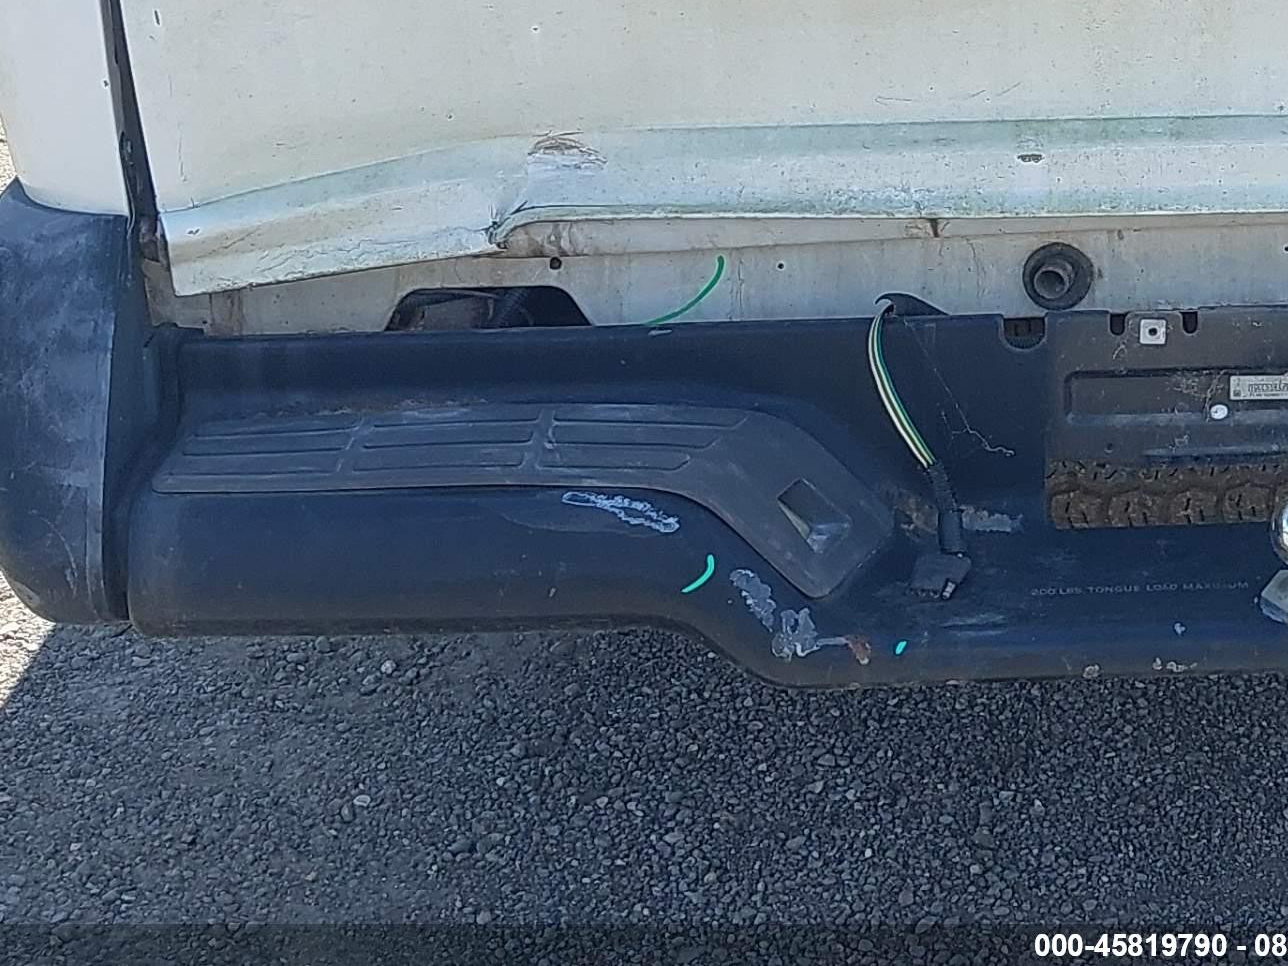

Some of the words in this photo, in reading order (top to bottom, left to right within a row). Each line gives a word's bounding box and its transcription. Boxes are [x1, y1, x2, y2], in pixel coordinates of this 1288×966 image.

[1087, 584, 1140, 594] TONGUE
[1146, 583, 1178, 592] LOAD
[1182, 581, 1249, 590] MAXIUM
